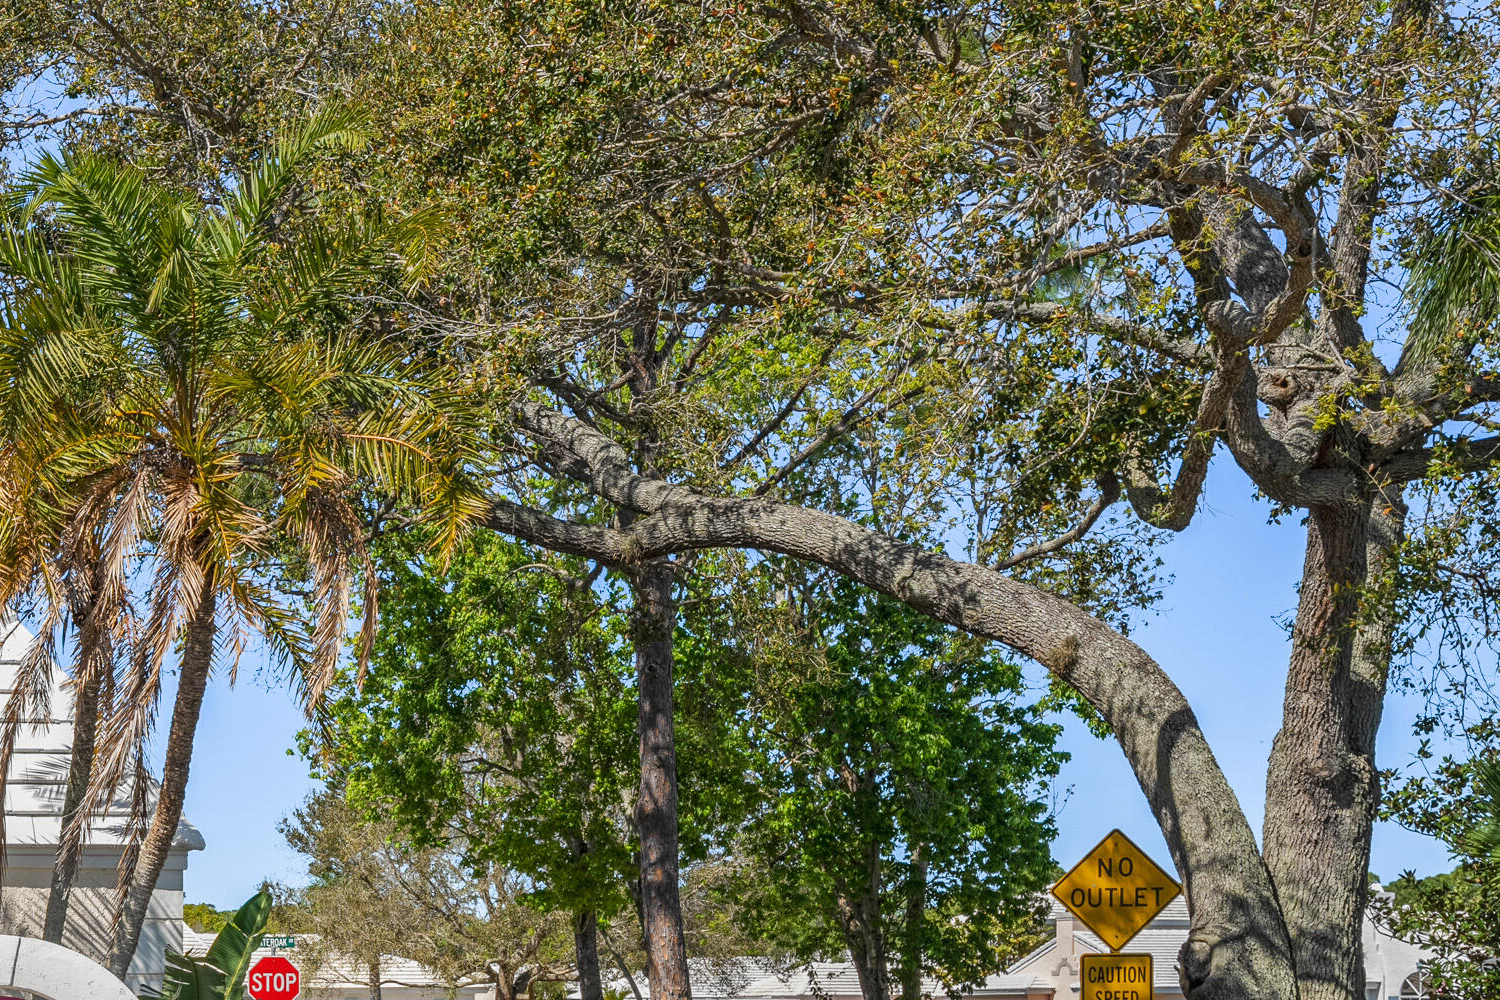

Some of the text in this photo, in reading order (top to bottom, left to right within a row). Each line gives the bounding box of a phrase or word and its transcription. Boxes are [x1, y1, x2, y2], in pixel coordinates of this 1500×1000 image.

[1097, 857, 1134, 878] NO
[1070, 886, 1165, 908] OUTLET
[251, 972, 297, 992] STOP
[1088, 966, 1147, 984] CAUTION
